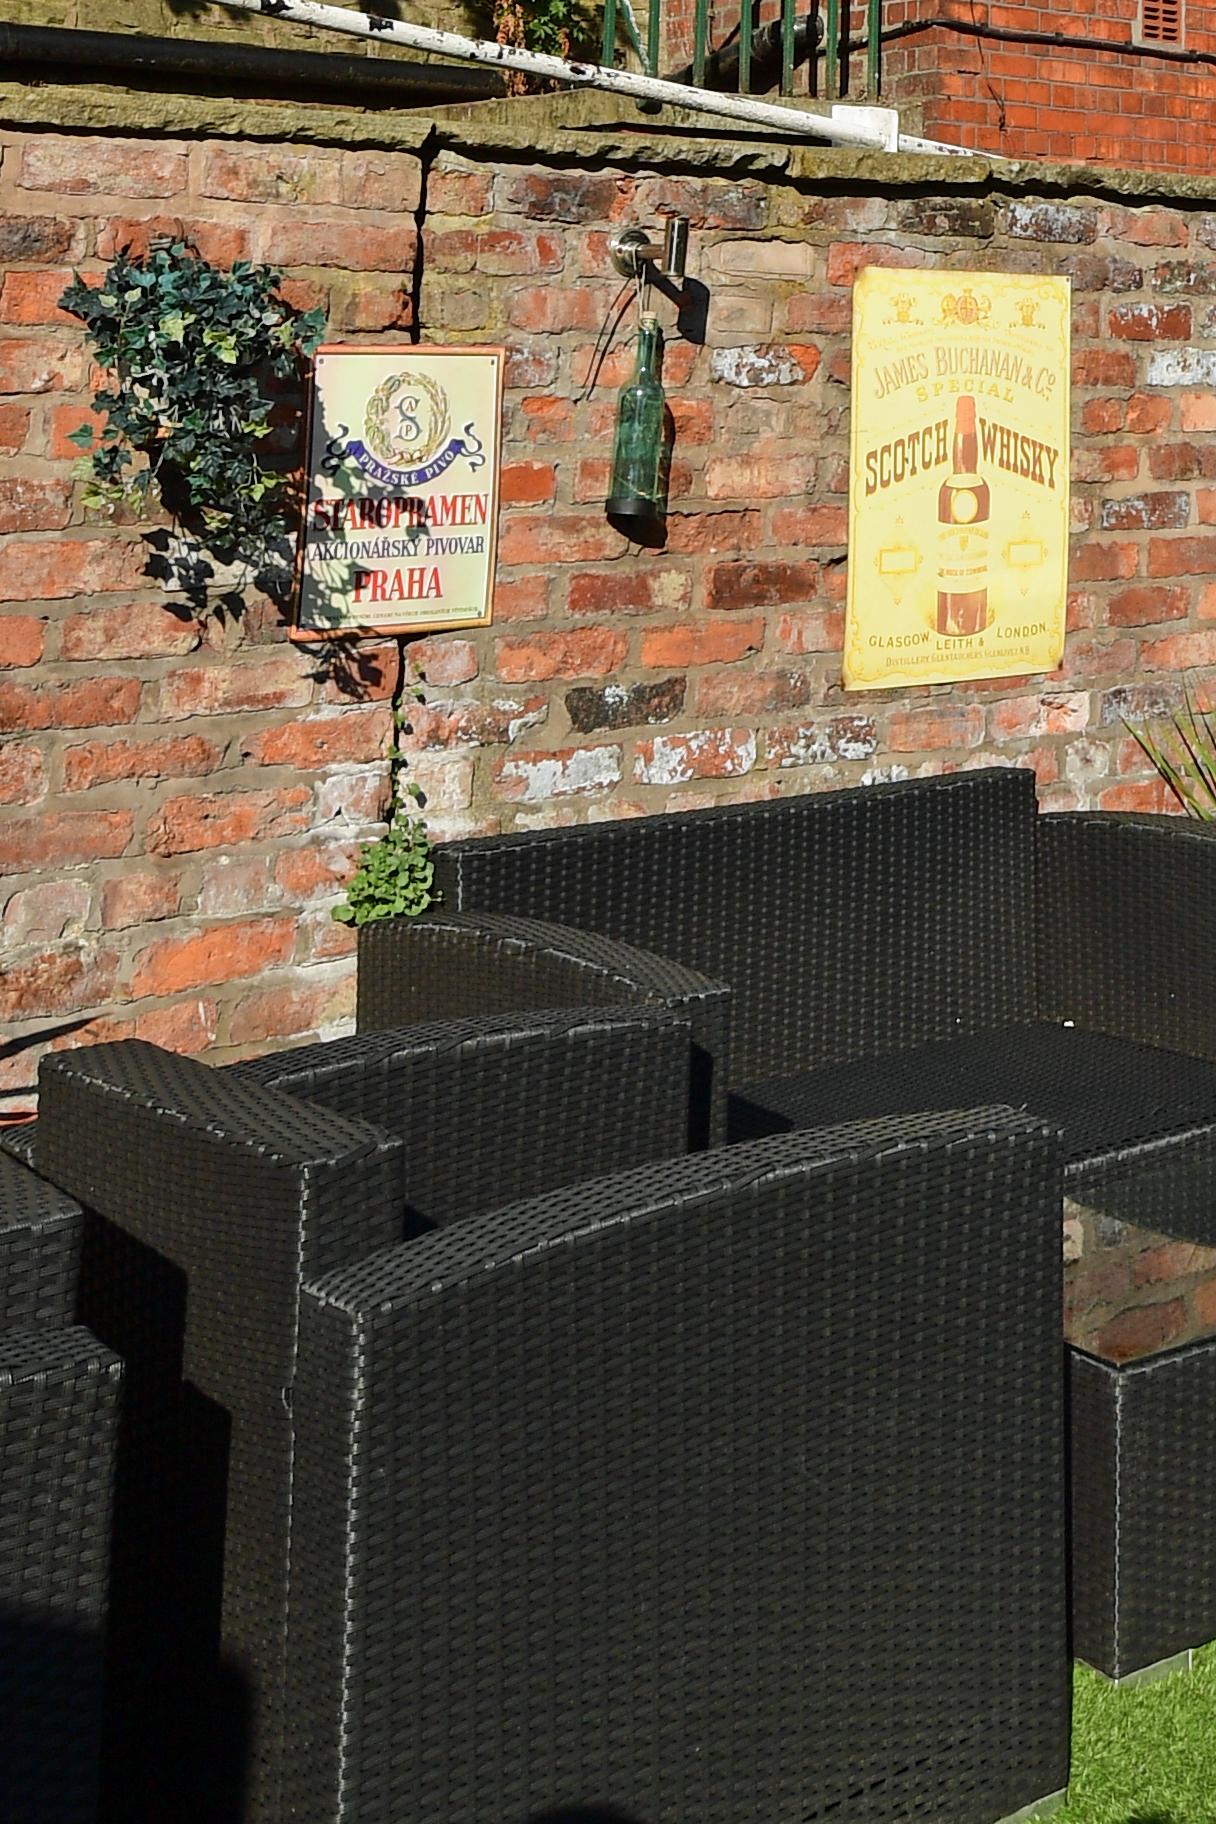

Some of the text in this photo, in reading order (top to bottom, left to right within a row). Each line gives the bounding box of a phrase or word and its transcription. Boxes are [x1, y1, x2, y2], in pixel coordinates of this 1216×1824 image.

[874, 352, 929, 399] JAMES
[934, 346, 1023, 384] BUCHANAN
[915, 378, 1015, 403] SPECIAL
[358, 450, 455, 485] PRAŽSKÉ PIVO
[865, 416, 1059, 497] SCOTCH WHISKY
[312, 493, 489, 532] STAROPRAMEN
[311, 534, 485, 562] AKCIONÁŘSKÝ PIVOVAR
[352, 566, 443, 604] PRAHA
[885, 655, 930, 667] DISTILLERY
[936, 638, 973, 651] LEITH
[978, 637, 985, 647] &
